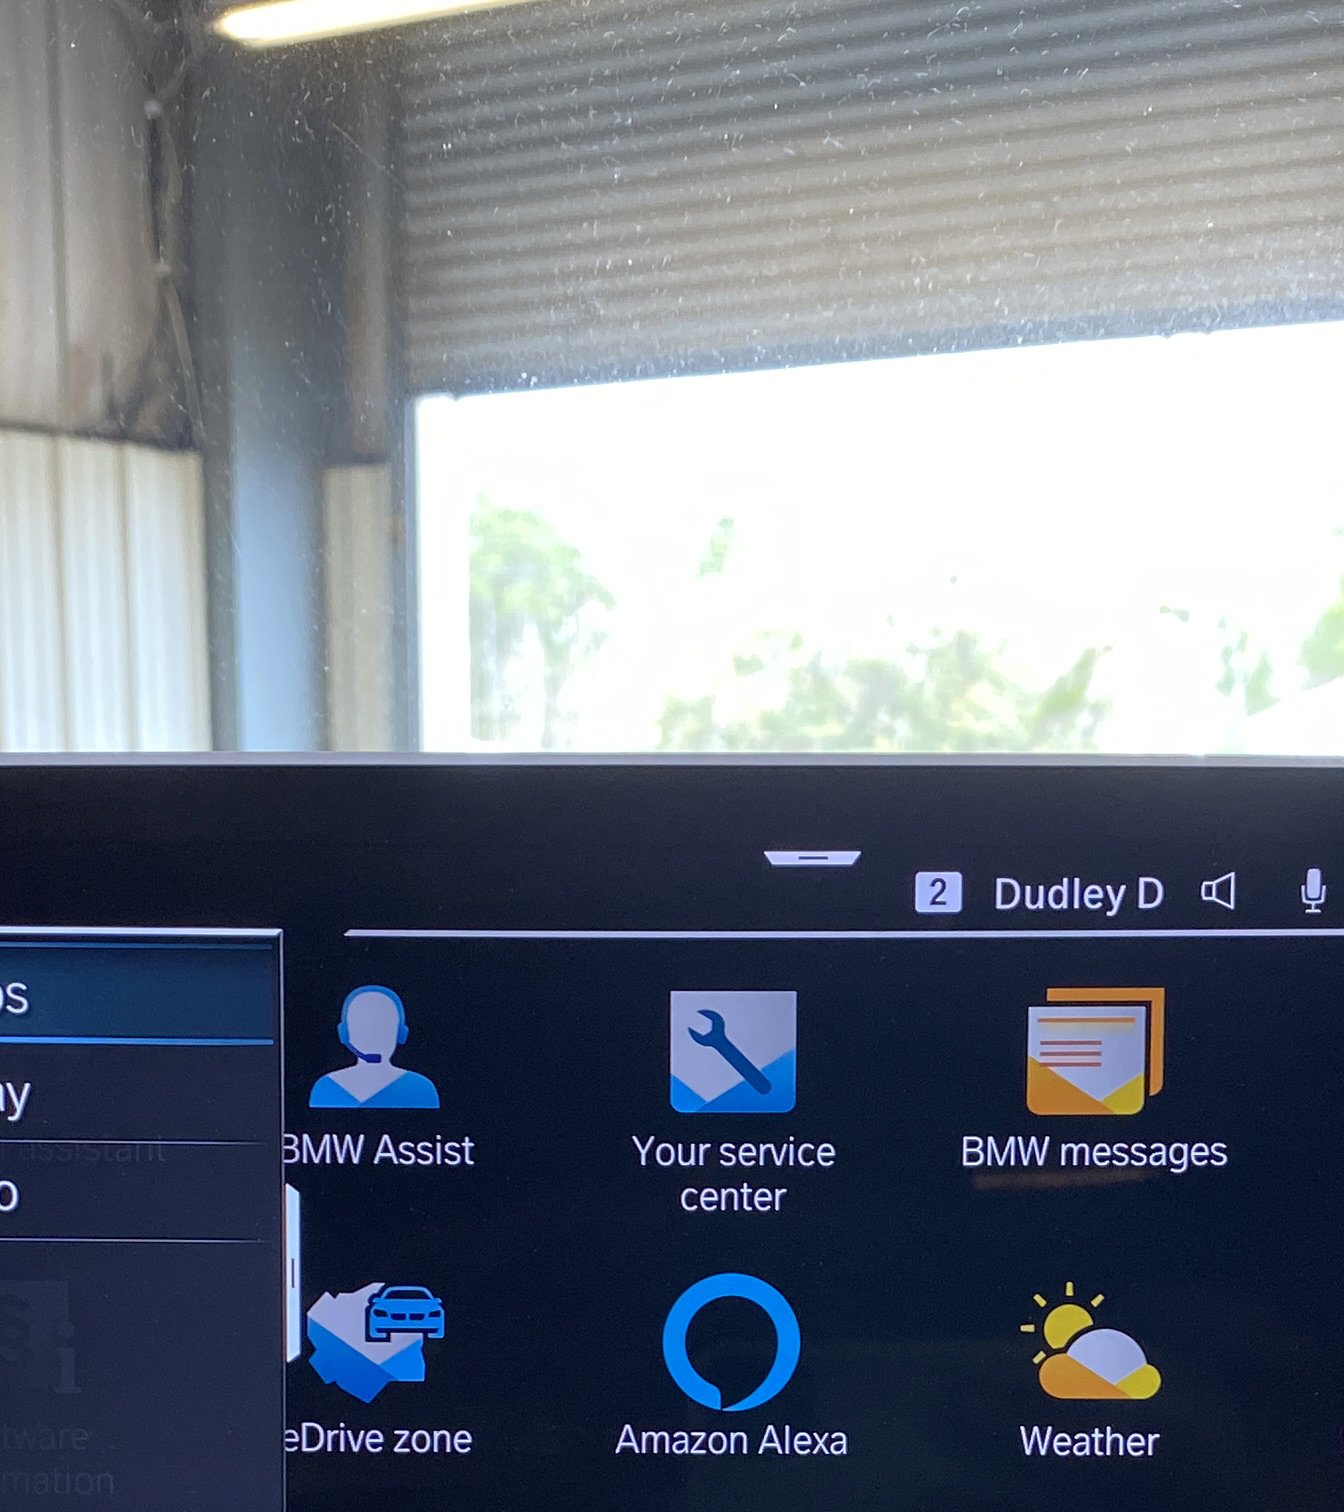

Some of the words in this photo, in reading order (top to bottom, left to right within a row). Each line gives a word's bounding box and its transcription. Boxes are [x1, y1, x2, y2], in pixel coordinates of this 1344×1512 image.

[929, 877, 947, 906] 2
[995, 877, 1127, 917] Dudley
[1138, 876, 1164, 909] D
[373, 1134, 475, 1166] Assist
[631, 1135, 712, 1167] Your
[719, 1135, 836, 1167] service
[962, 1135, 1050, 1167] BMW
[1060, 1142, 1228, 1174] messages
[680, 1182, 788, 1212] center
[284, 1422, 384, 1453] eDrive
[393, 1429, 473, 1454] zone
[615, 1423, 748, 1455] Amazon
[757, 1424, 847, 1456] Alexa
[1019, 1425, 1161, 1457] Weather
